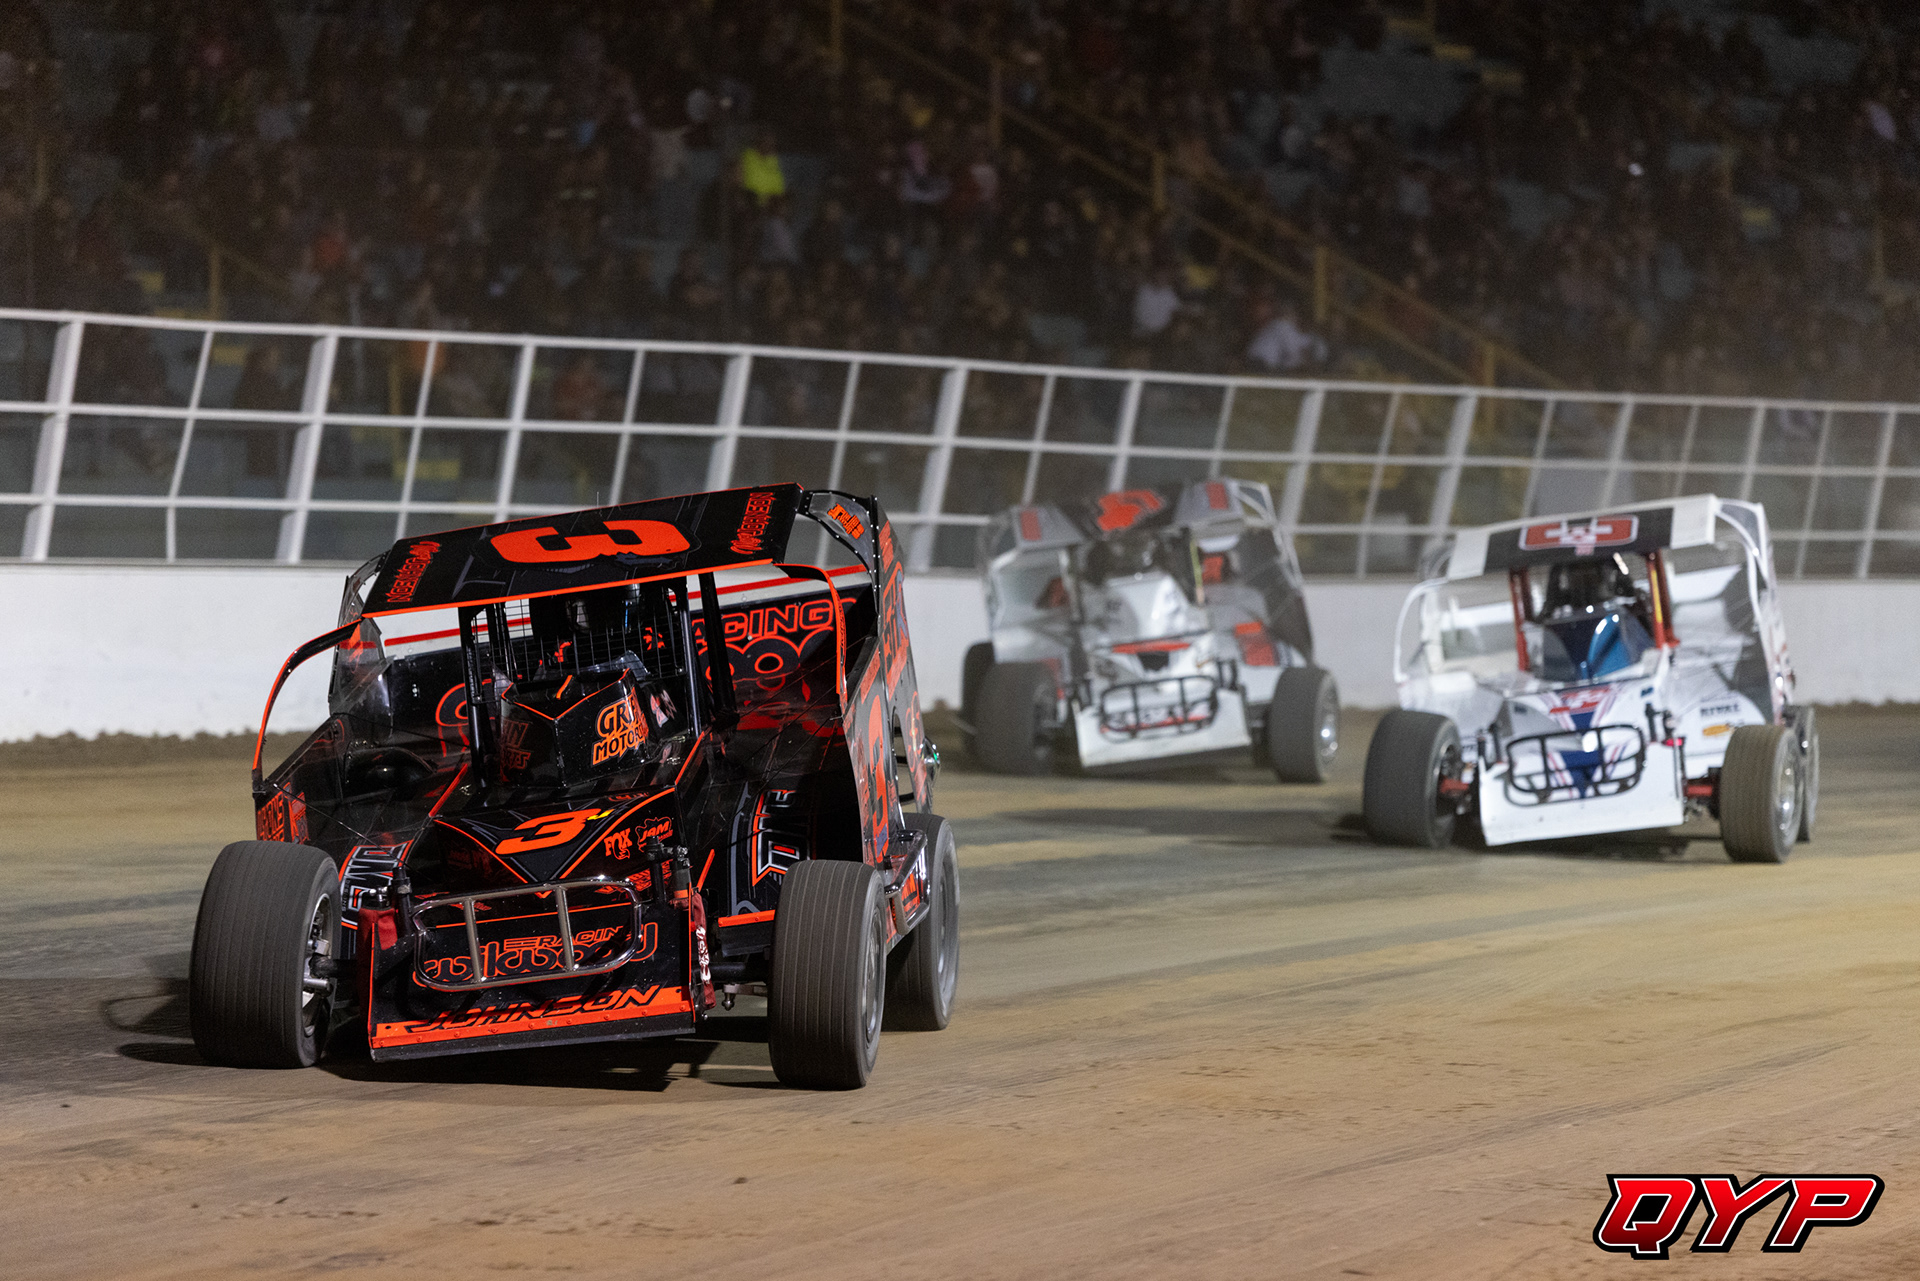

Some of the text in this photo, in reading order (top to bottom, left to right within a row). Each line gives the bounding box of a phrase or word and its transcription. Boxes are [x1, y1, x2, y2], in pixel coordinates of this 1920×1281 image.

[490, 519, 691, 564] 3
[495, 808, 602, 855] 3
[603, 827, 633, 857] FOX
[639, 820, 669, 843] JAM
[403, 985, 662, 1033] JOHNSON
